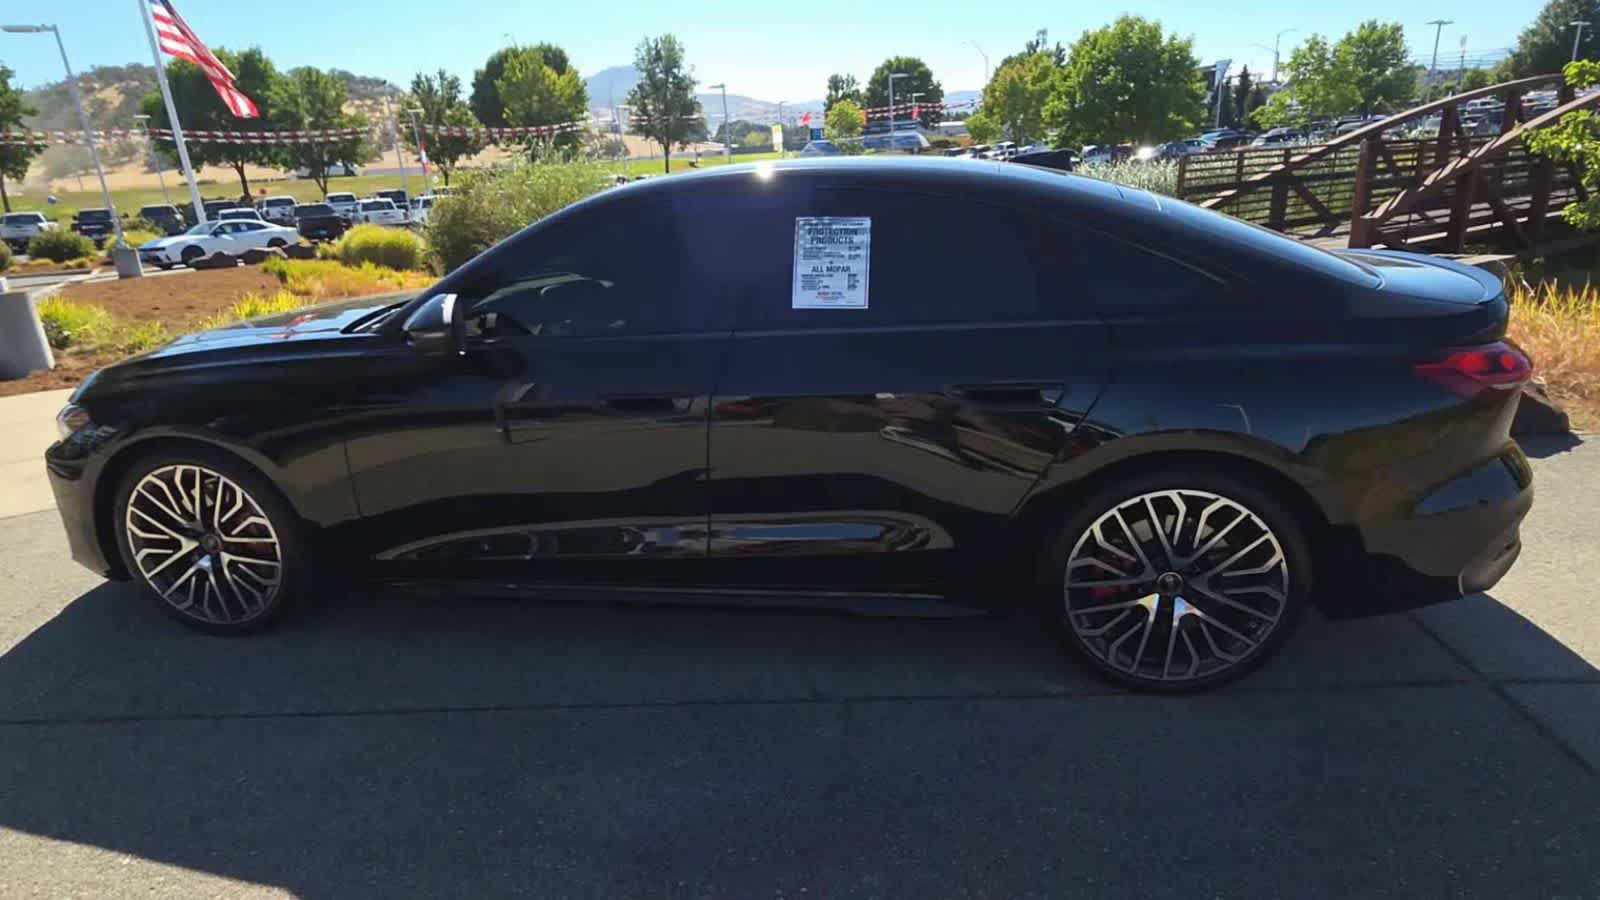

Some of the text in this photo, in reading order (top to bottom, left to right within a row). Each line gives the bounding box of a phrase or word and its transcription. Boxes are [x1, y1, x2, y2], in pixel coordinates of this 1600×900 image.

[807, 228, 858, 236] PROTECTION
[810, 237, 855, 245] PRODUCTS
[811, 265, 851, 273] ALL MOPAR
